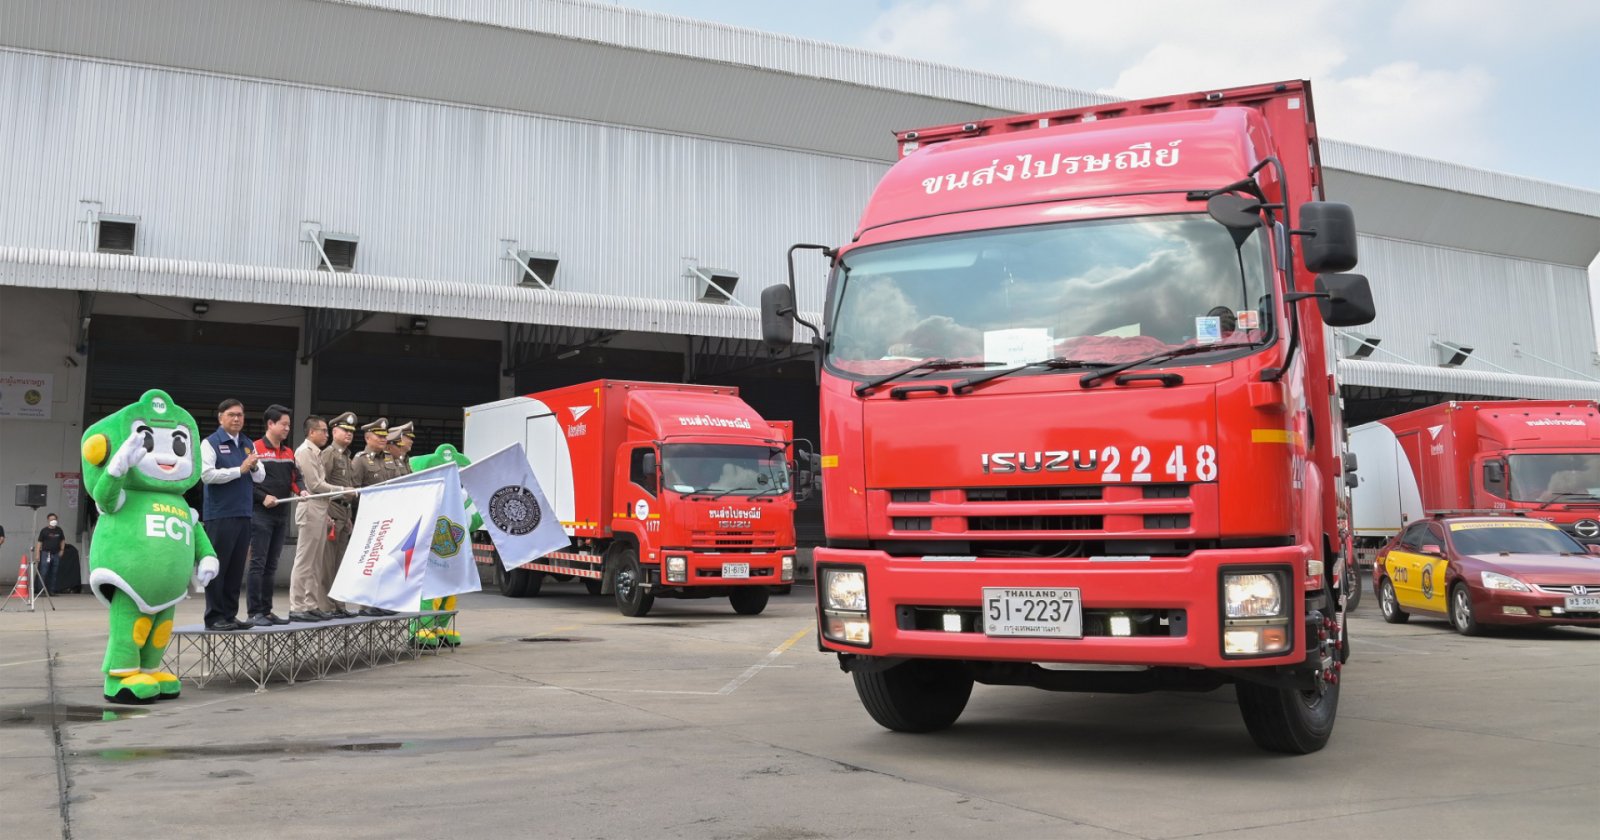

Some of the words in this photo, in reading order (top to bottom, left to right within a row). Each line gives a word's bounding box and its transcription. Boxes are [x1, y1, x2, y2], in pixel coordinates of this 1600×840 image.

[922, 139, 1183, 195] ขนส่งไปรษณีย์
[980, 449, 1097, 474] ISUZU
[152, 503, 188, 520] SMART
[145, 514, 192, 546] ECT
[718, 520, 751, 528] ISUZU
[989, 599, 1073, 622] 51-2237
